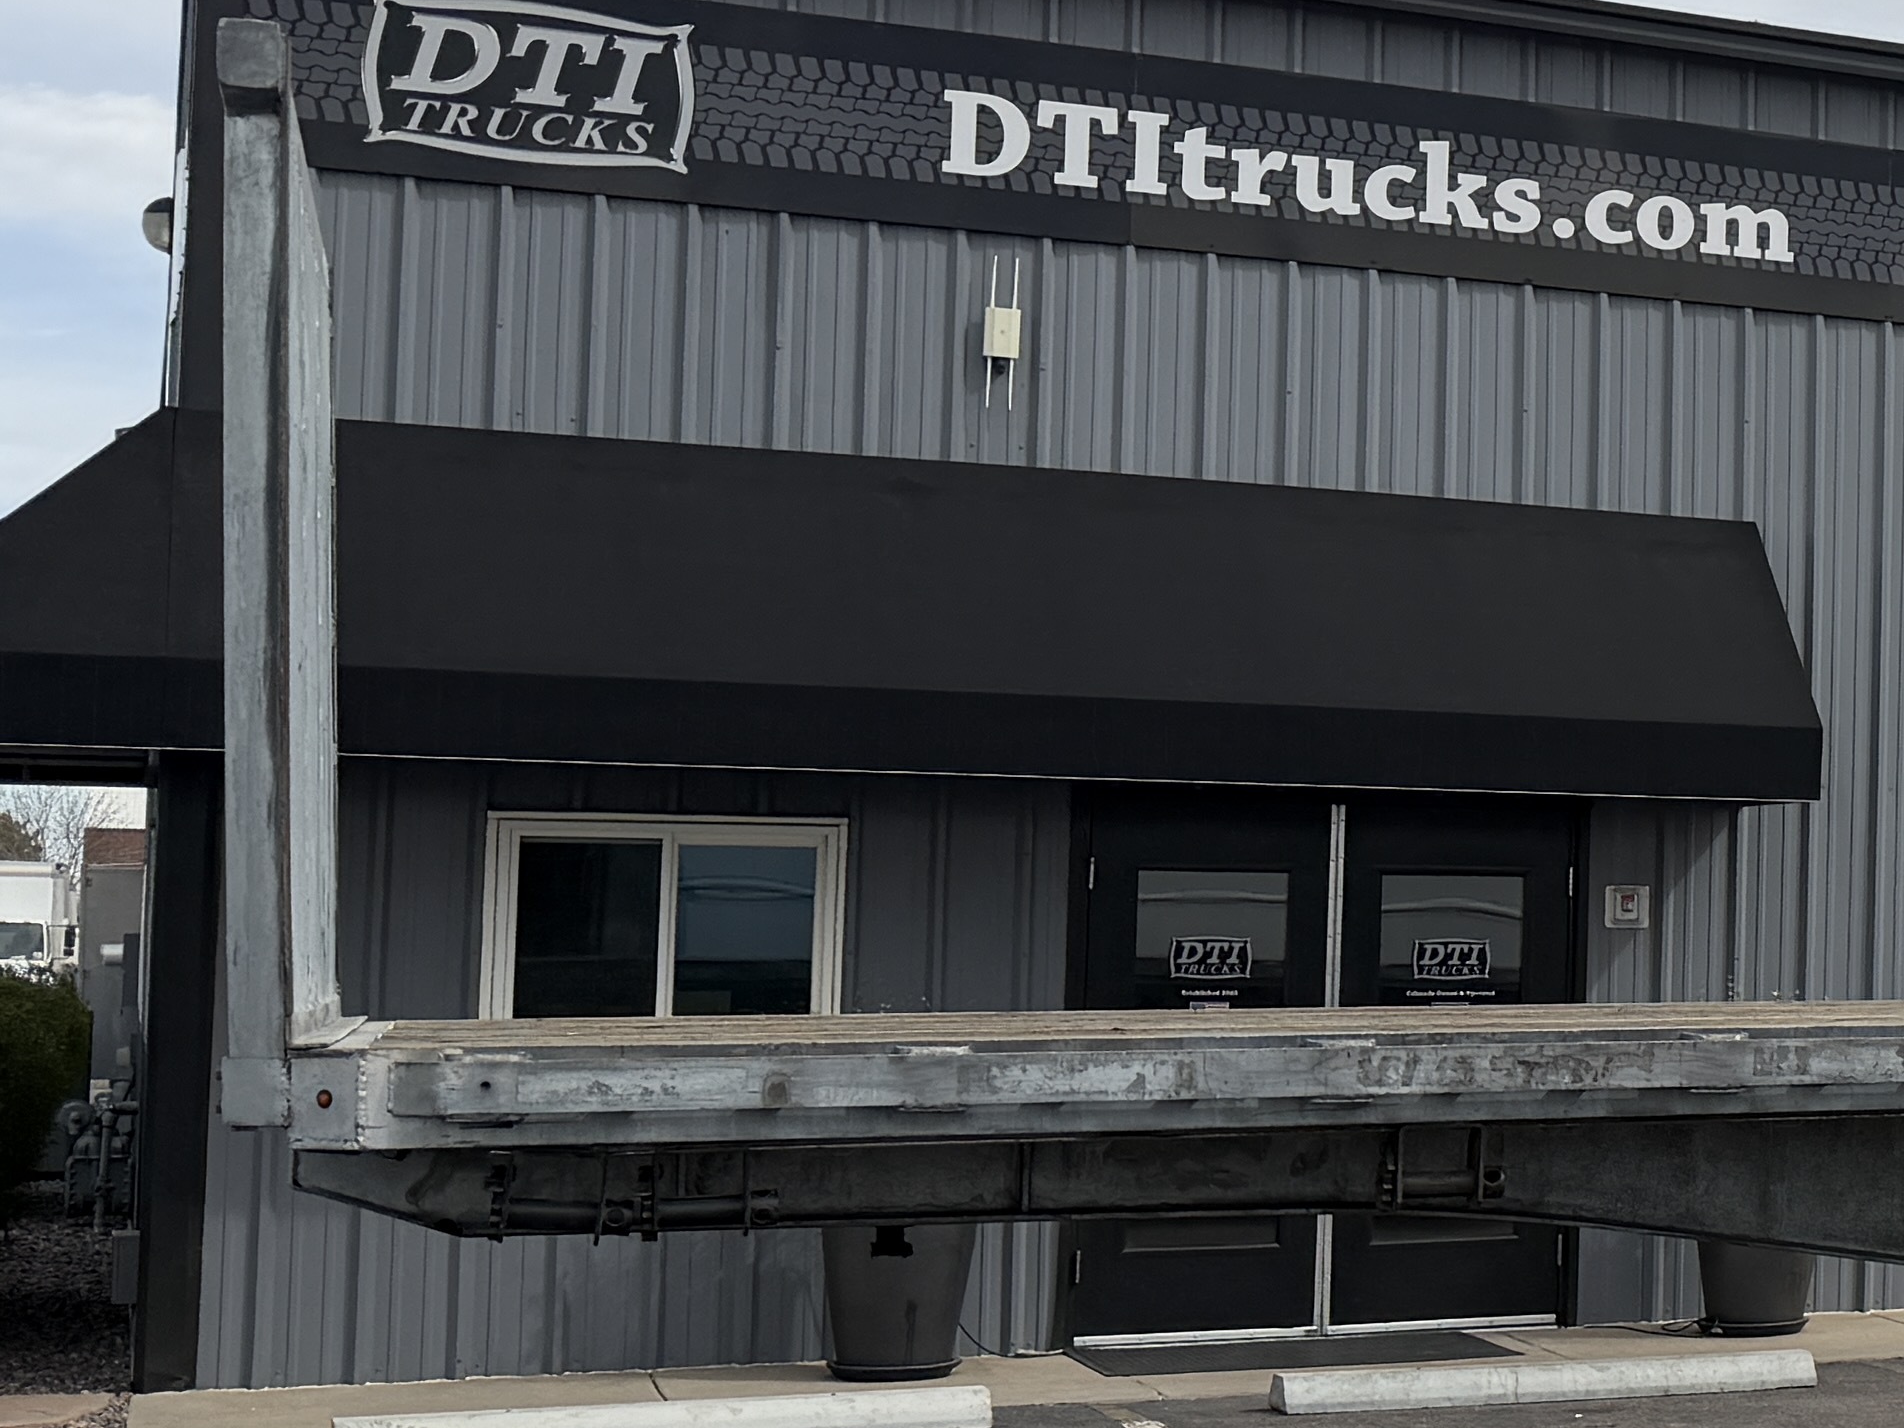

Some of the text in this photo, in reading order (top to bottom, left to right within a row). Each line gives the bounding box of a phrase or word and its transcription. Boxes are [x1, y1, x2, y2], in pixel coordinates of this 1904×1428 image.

[387, 12, 668, 116] DTI
[401, 98, 654, 154] TRUCKS
[942, 89, 1795, 263] DTItrucks.com
[1176, 942, 1244, 963] DTI
[1419, 944, 1484, 965] DTI
[1180, 964, 1242, 974] TRUCKS
[1423, 966, 1482, 975] TRUCKS
